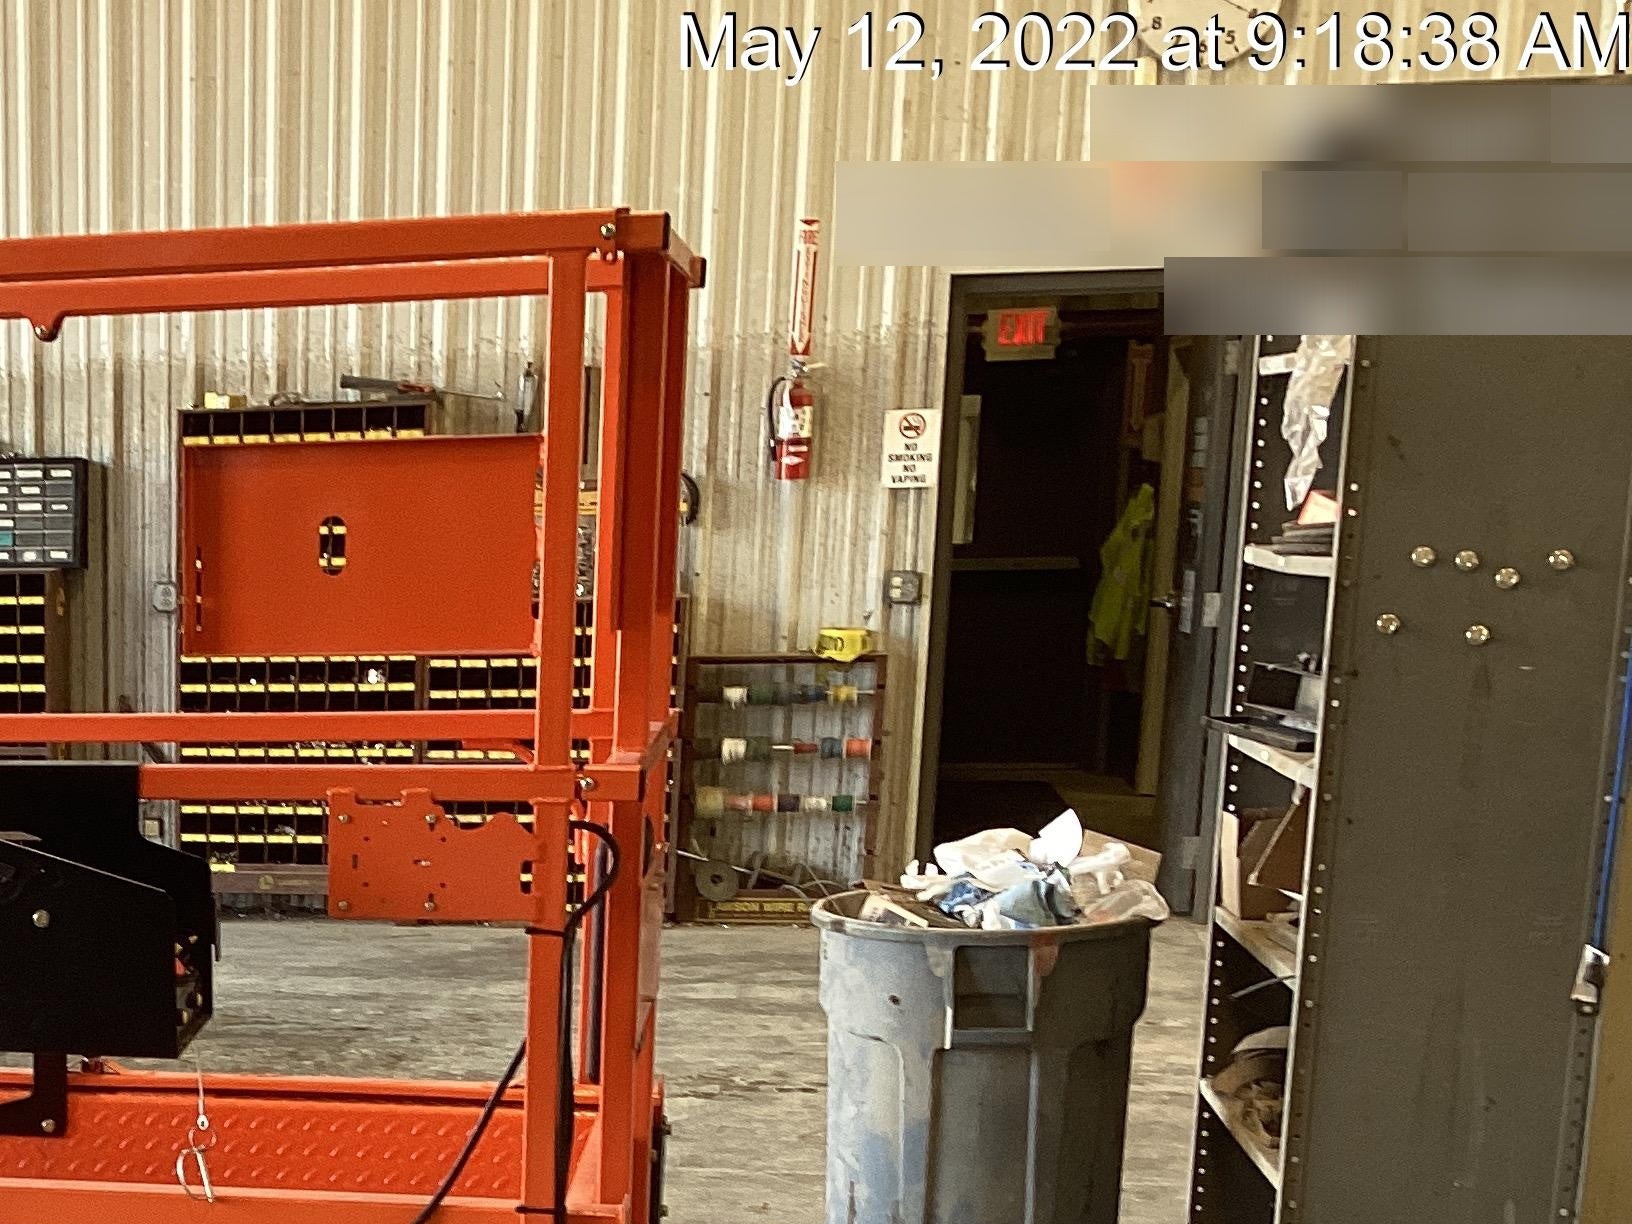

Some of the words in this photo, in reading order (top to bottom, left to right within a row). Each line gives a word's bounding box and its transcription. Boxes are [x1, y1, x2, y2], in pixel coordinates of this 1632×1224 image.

[997, 311, 1047, 346] EXIT
[904, 443, 918, 451] NO
[888, 453, 933, 462] SMOKING
[903, 464, 916, 472] NO
